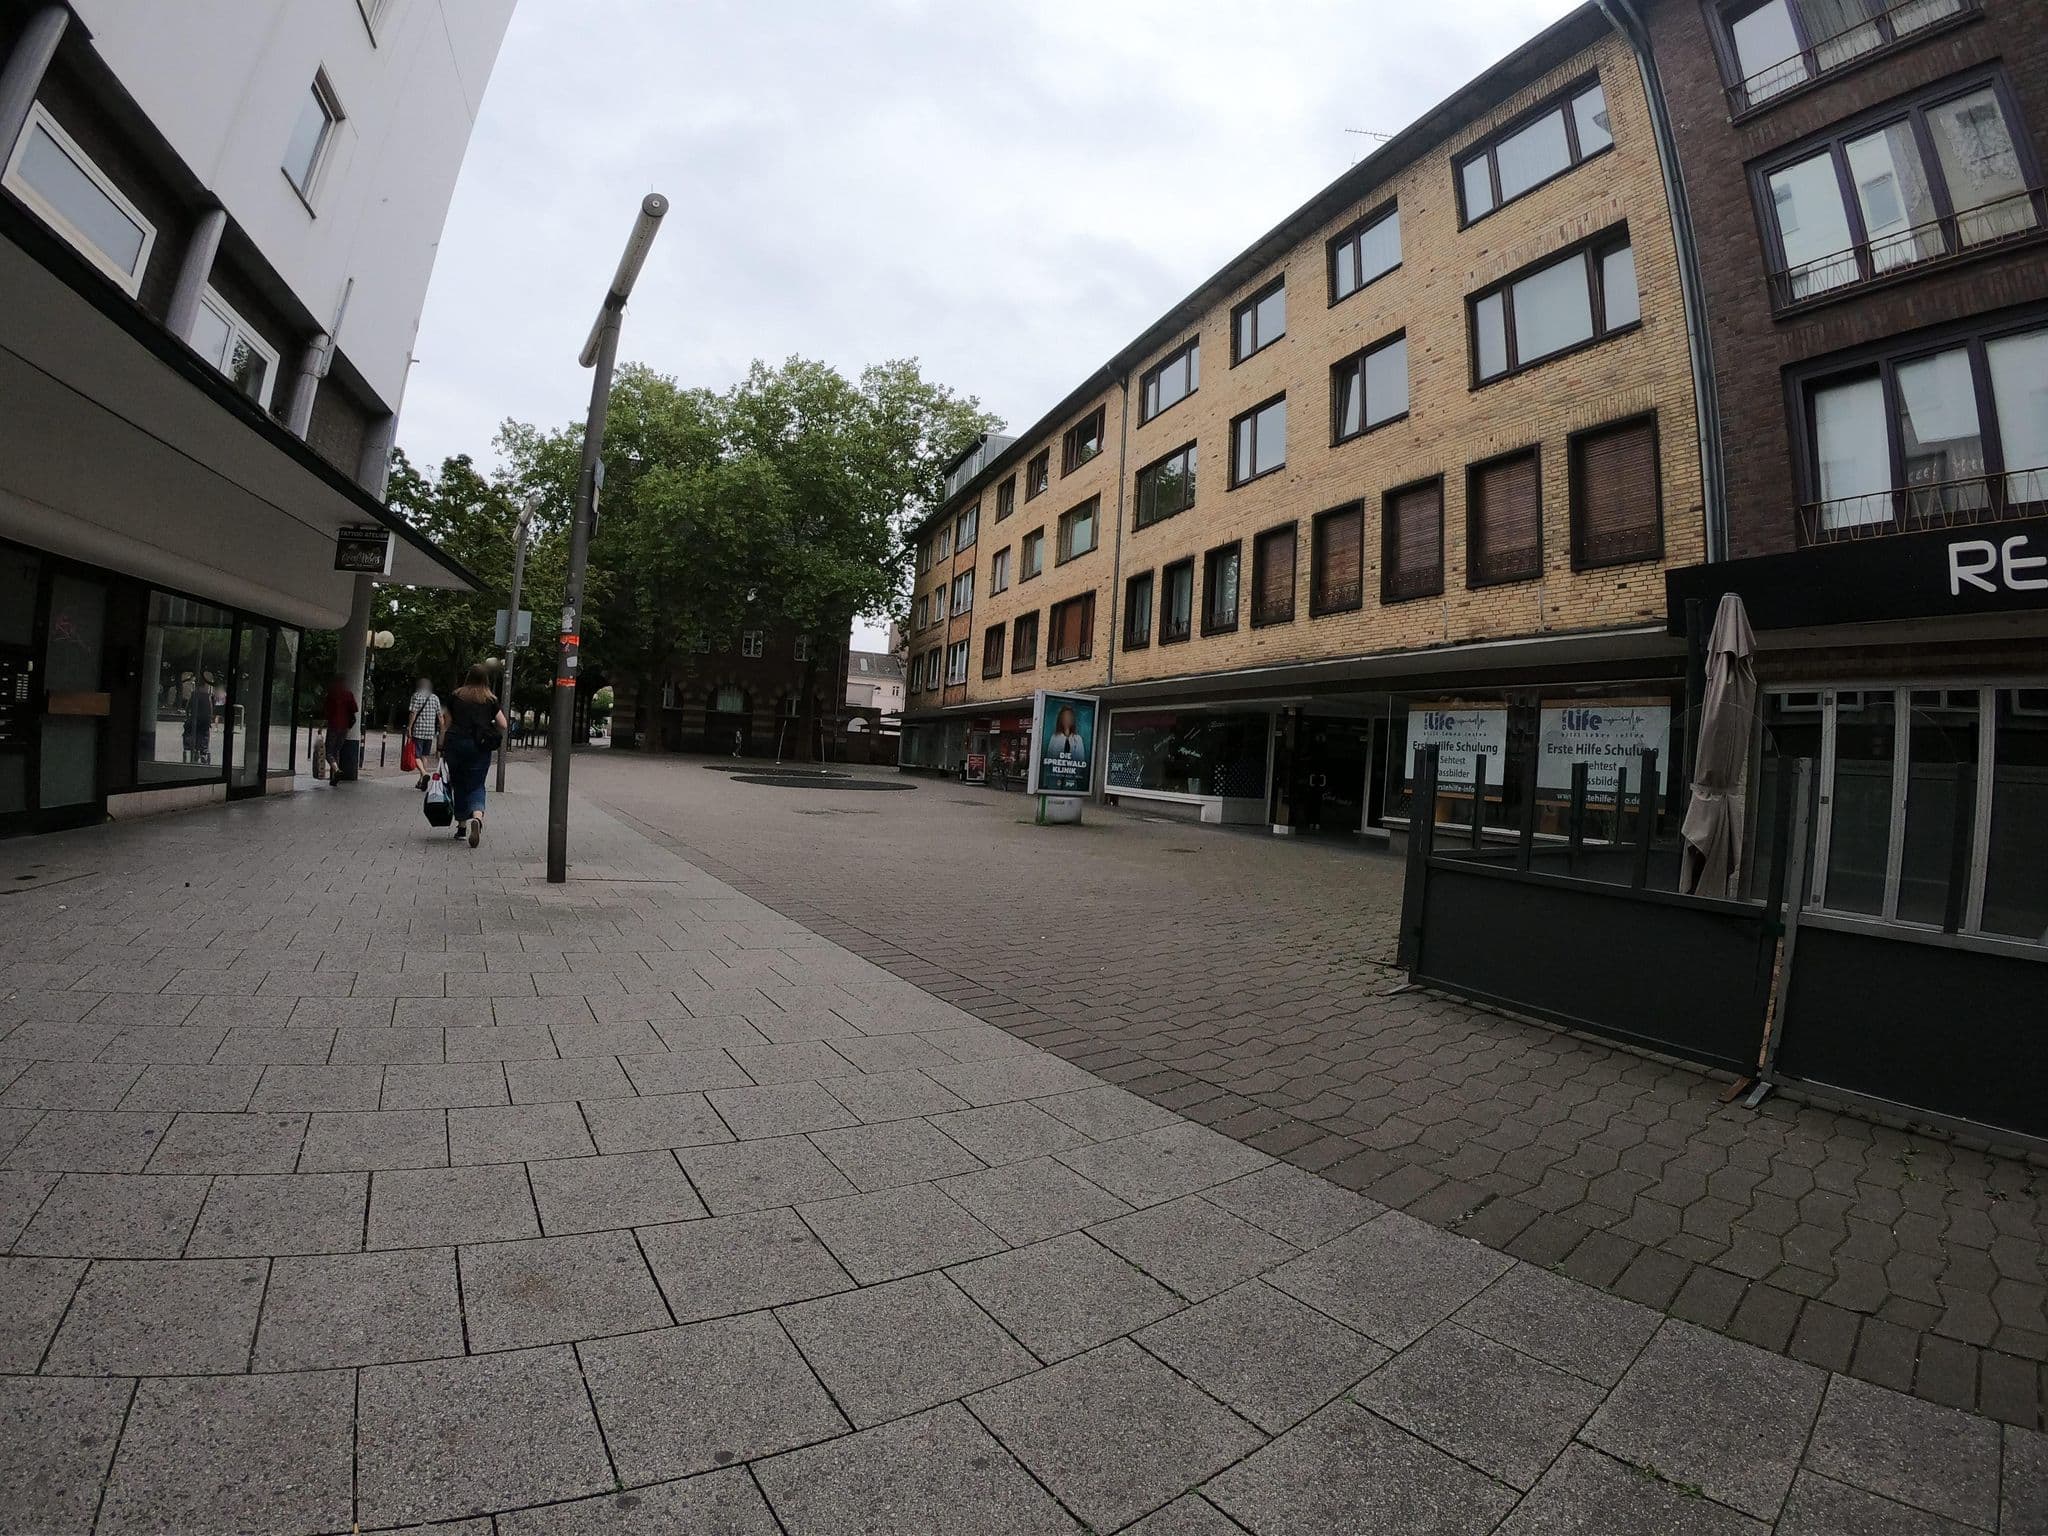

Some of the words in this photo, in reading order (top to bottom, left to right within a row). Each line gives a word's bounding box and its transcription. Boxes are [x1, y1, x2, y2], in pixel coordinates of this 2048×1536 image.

[1456, 741, 1498, 756] Schulung
[1547, 743, 1573, 755] Erste
[1575, 743, 1602, 756] Hilfe
[1059, 752, 1072, 760] DIE
[1440, 755, 1466, 766] Sehtest
[1043, 757, 1087, 768] SPREEWALD
[1052, 766, 1077, 774] KLINIK
